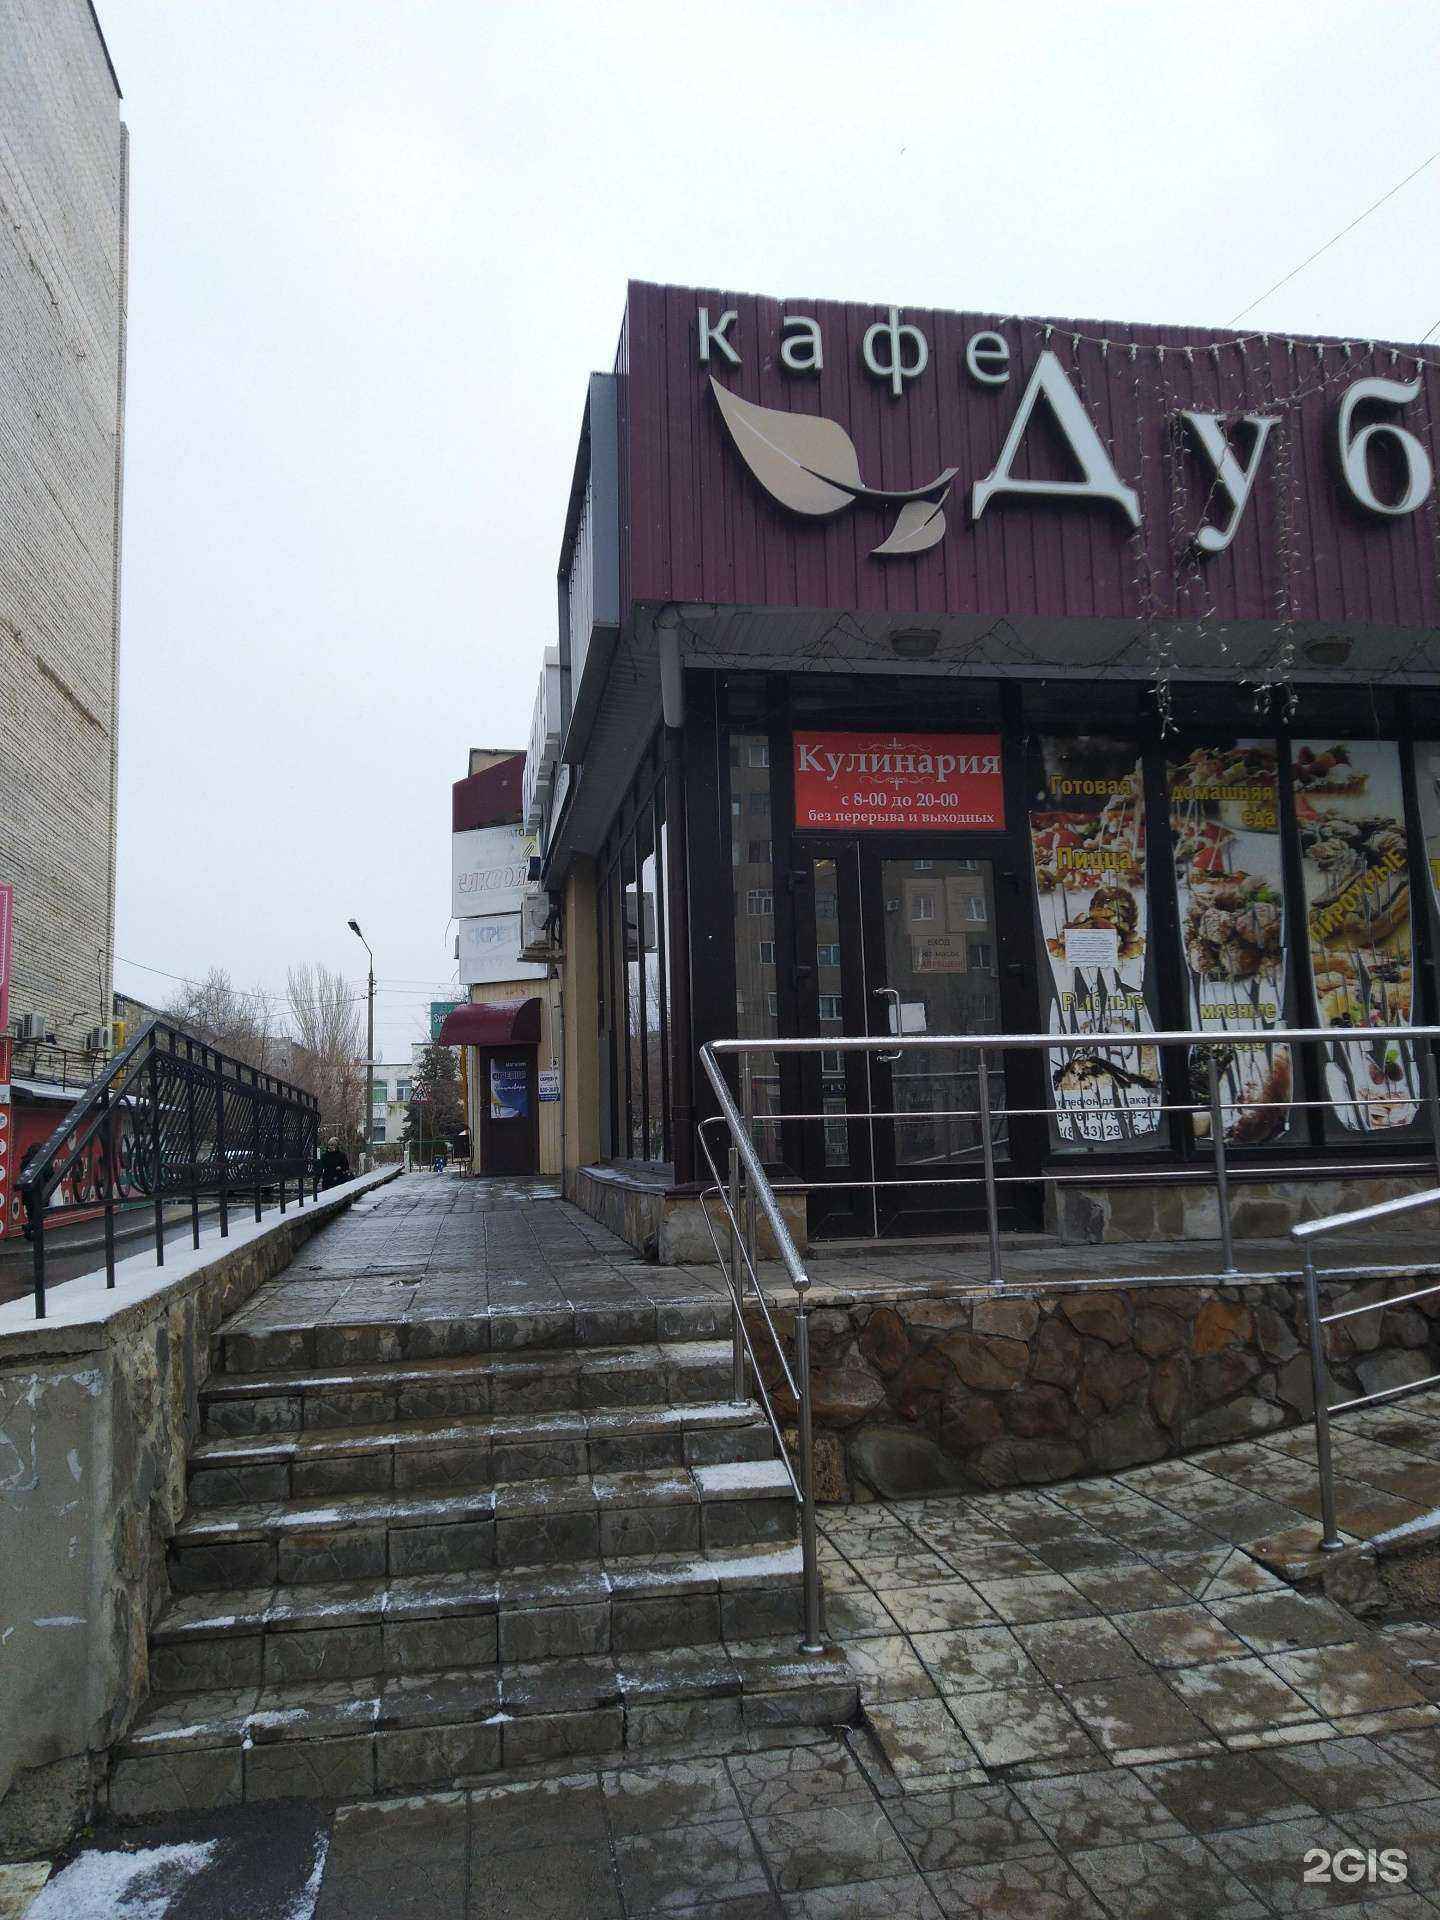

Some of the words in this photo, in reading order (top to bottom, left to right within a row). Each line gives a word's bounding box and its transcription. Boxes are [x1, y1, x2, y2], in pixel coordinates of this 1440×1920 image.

[698, 305, 1010, 395] кафе
[972, 351, 1433, 553] Дуб
[797, 744, 1000, 783] Кулинария
[1050, 773, 1132, 796] Готовая
[841, 796, 849, 806] с
[854, 793, 887, 807] 8-00
[891, 795, 912, 808] до
[916, 793, 959, 807] 20-00
[808, 809, 831, 822] без
[835, 811, 905, 825] перерыва
[909, 813, 918, 823] и
[922, 813, 994, 824] выходных
[1241, 808, 1277, 827] еда
[1056, 847, 1132, 871] Пицца
